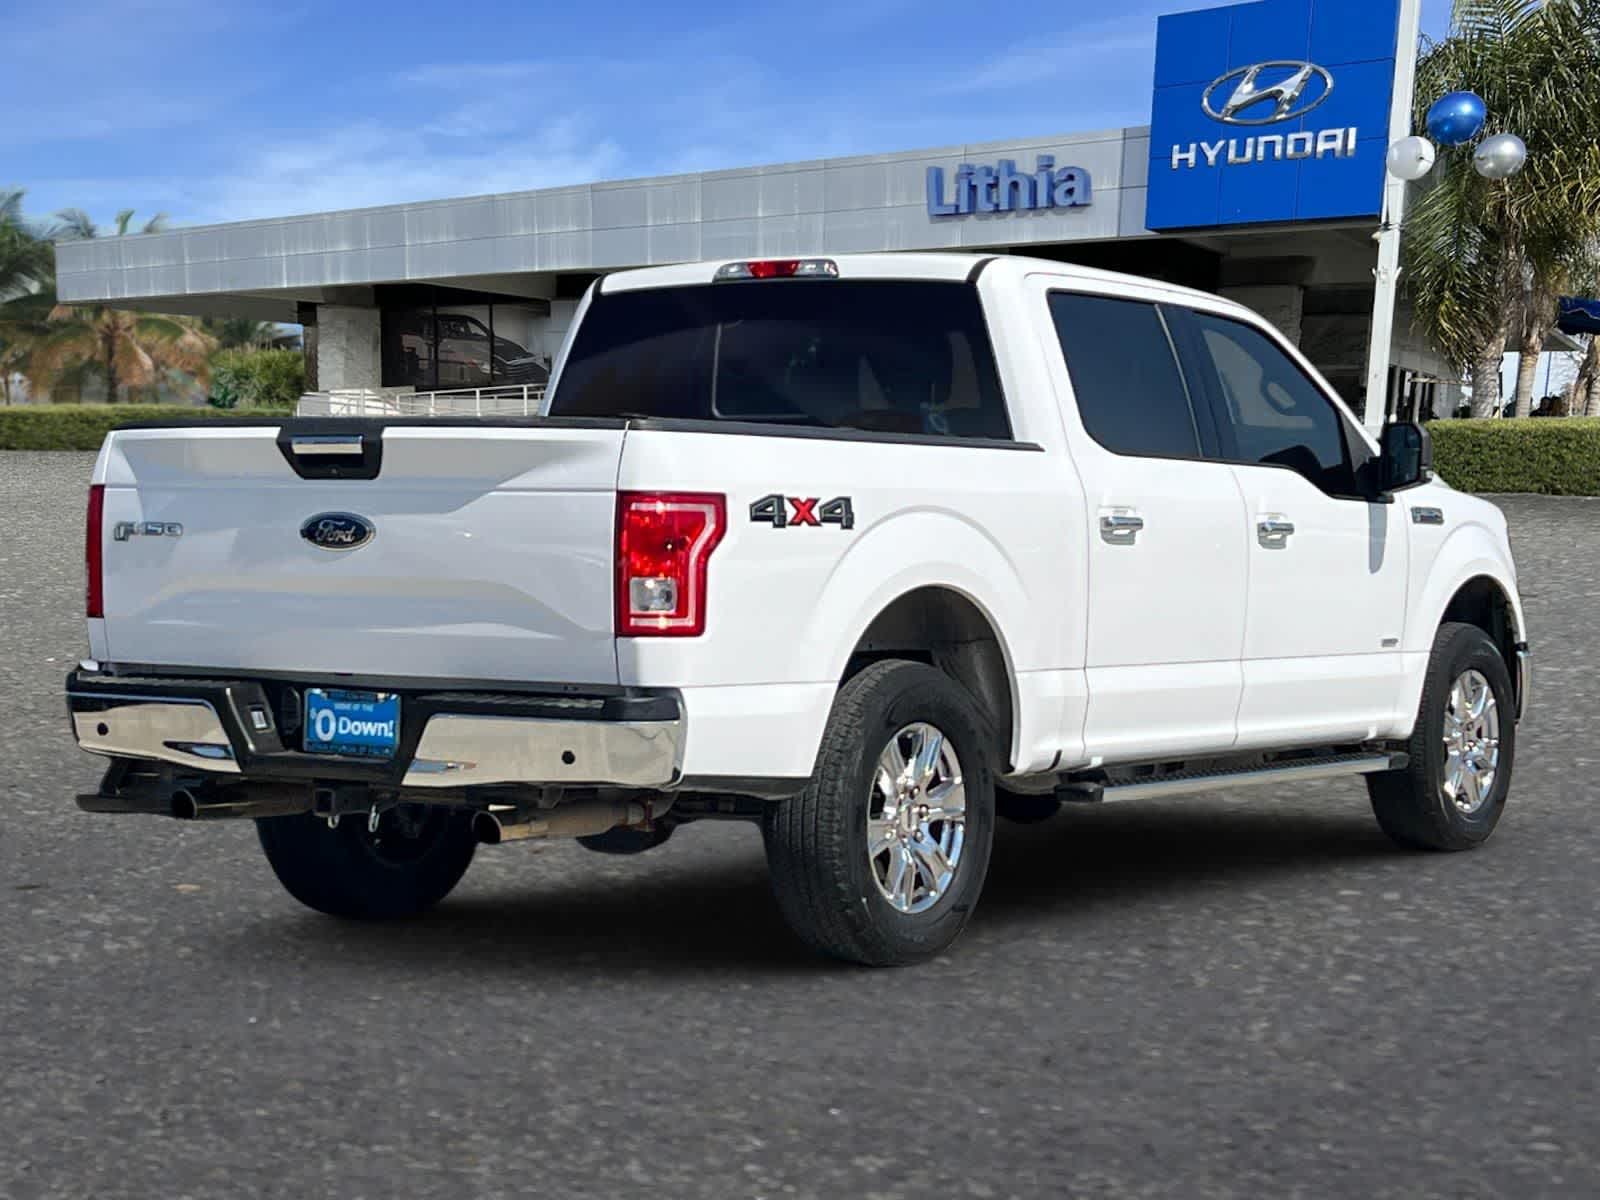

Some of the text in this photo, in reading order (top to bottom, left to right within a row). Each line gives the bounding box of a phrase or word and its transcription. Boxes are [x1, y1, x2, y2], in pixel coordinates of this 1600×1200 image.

[1171, 127, 1357, 169] HYUNDAI
[926, 154, 1092, 217] Lithia
[315, 519, 356, 543] Ford
[338, 717, 394, 738] Down!
